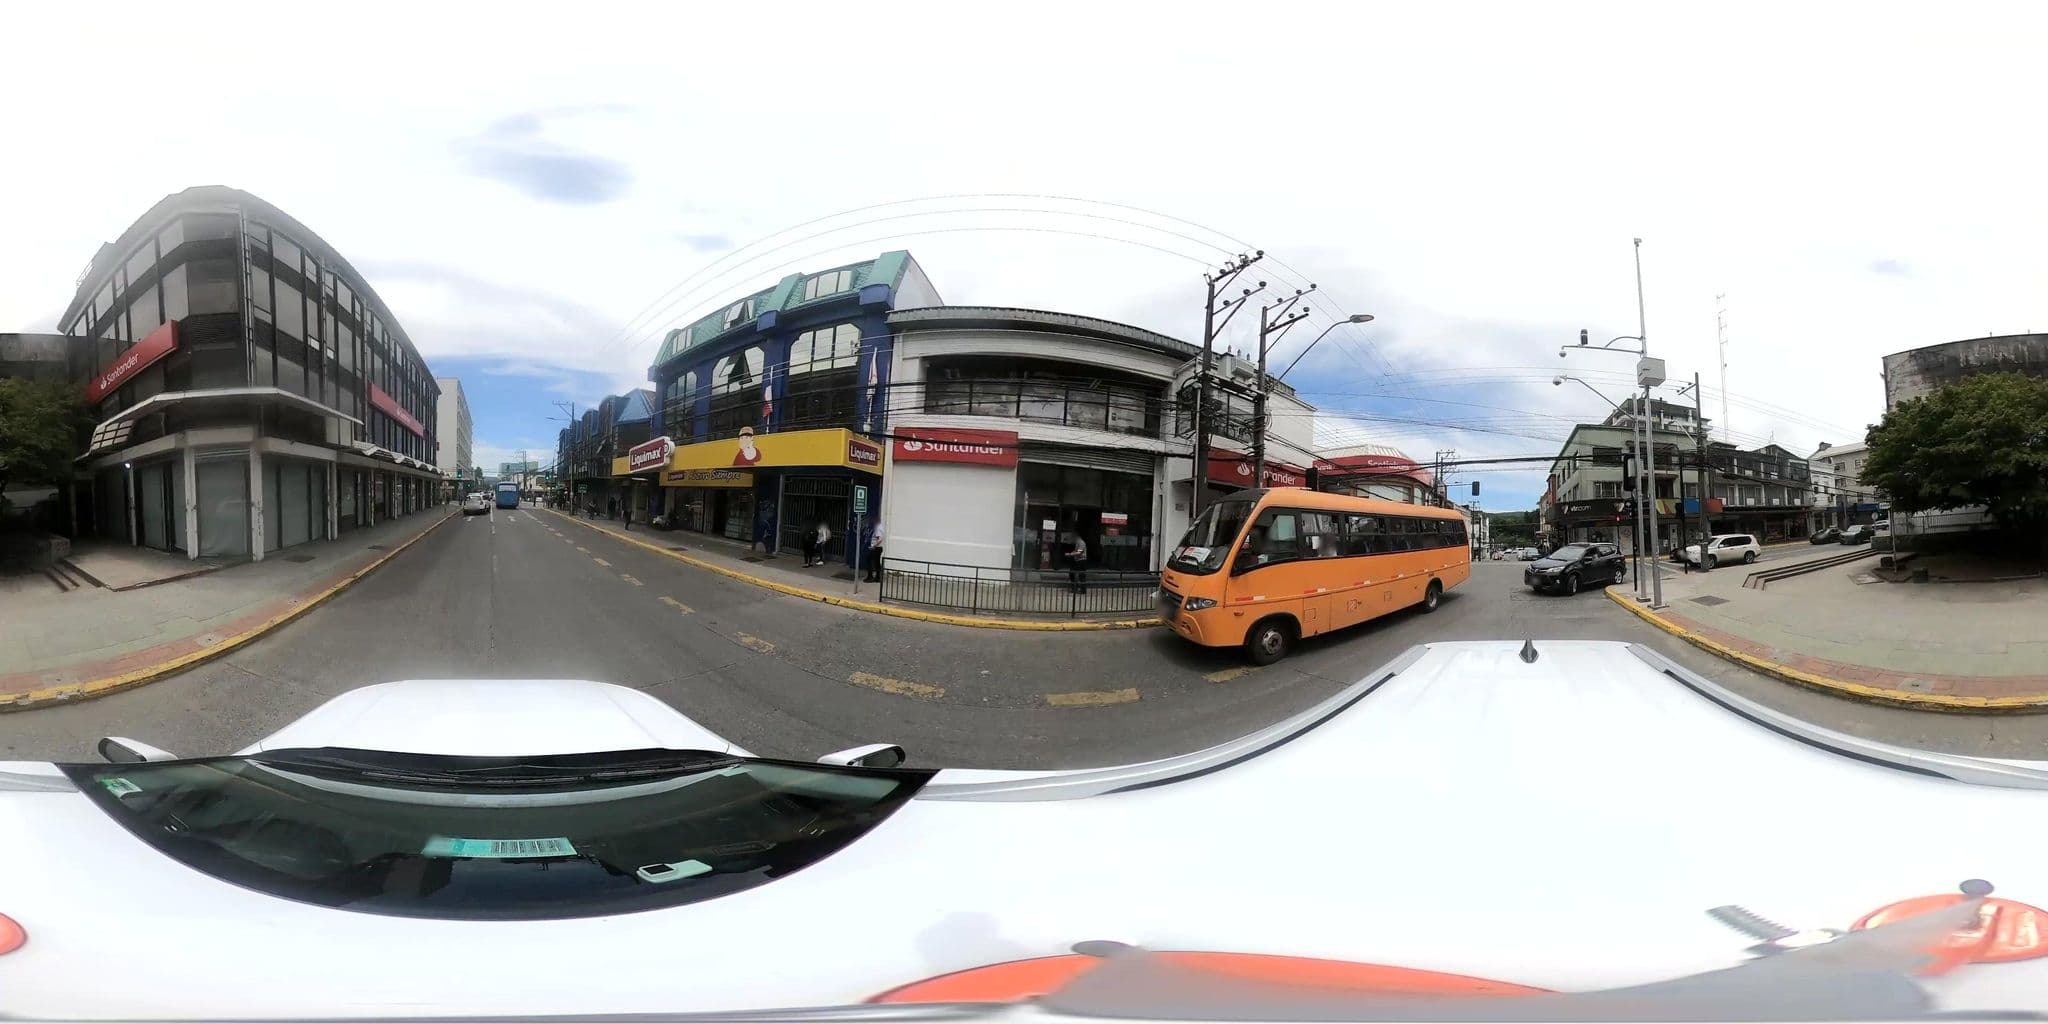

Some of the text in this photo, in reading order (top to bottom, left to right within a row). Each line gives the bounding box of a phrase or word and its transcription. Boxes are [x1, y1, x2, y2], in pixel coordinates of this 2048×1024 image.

[107, 353, 139, 385] Santander
[632, 447, 662, 467] Liquimax
[850, 445, 877, 461] Liquimax
